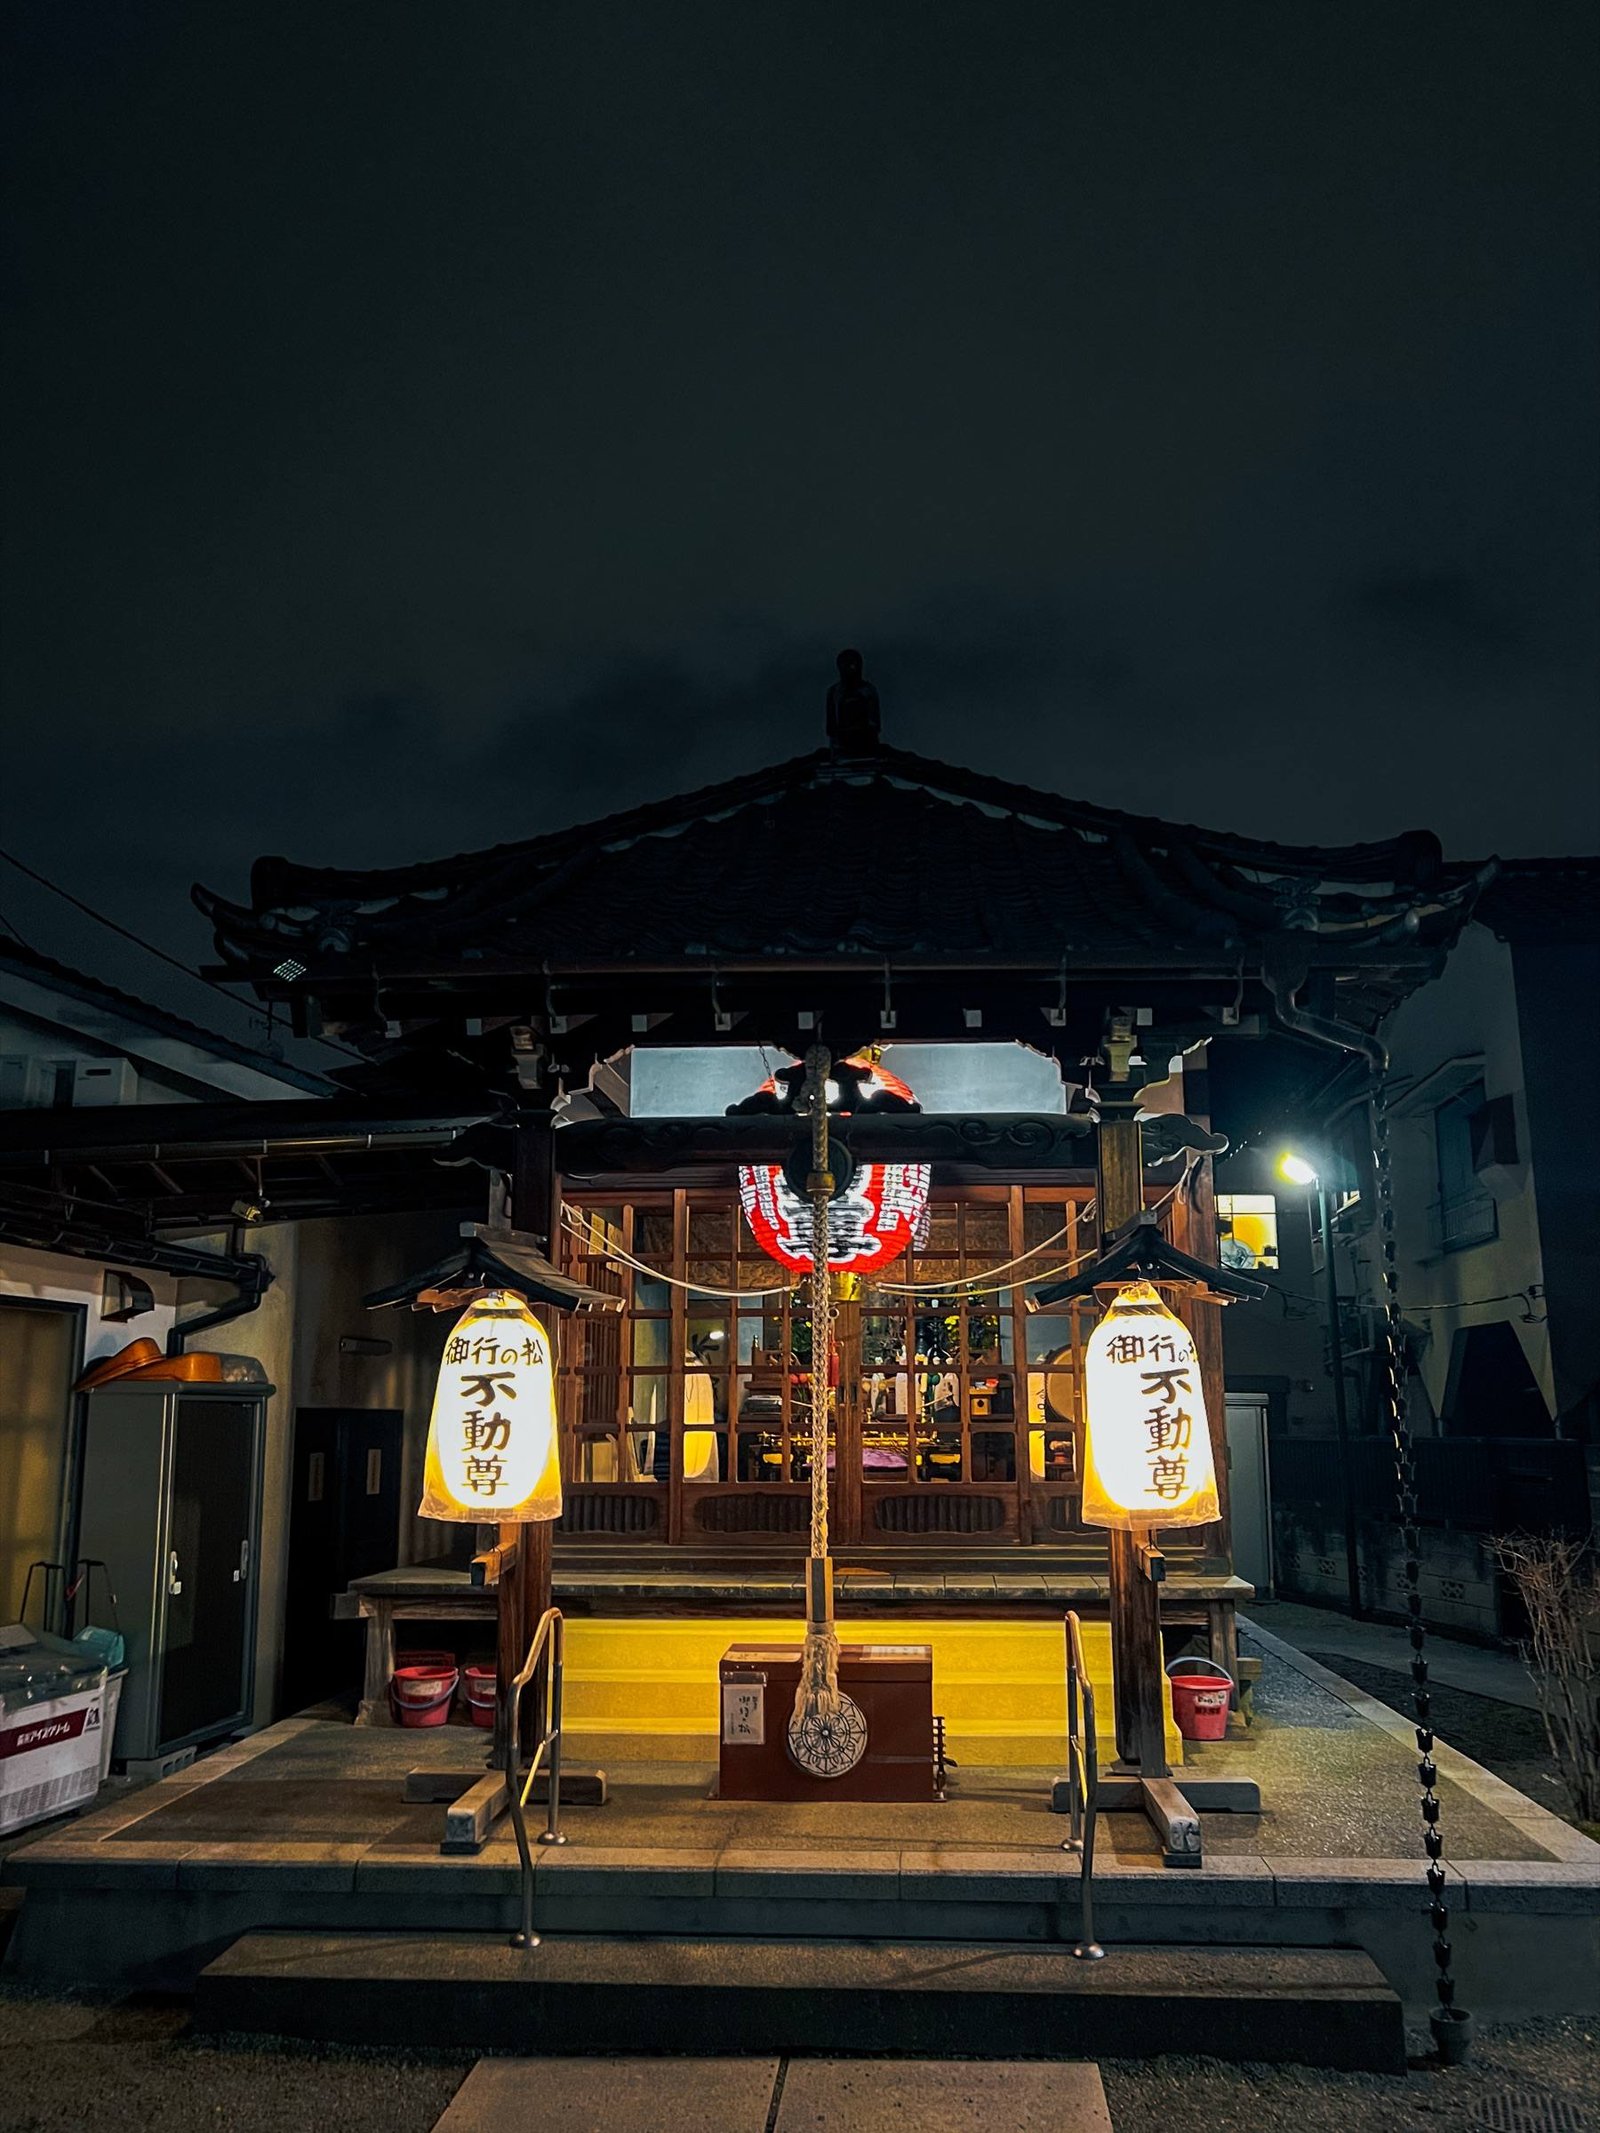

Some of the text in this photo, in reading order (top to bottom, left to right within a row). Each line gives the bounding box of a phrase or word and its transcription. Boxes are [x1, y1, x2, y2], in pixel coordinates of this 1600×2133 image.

[445, 1336, 543, 1366] 御行の松
[460, 1371, 517, 1496] 不動尊
[1140, 1368, 1192, 1500] 不動尊
